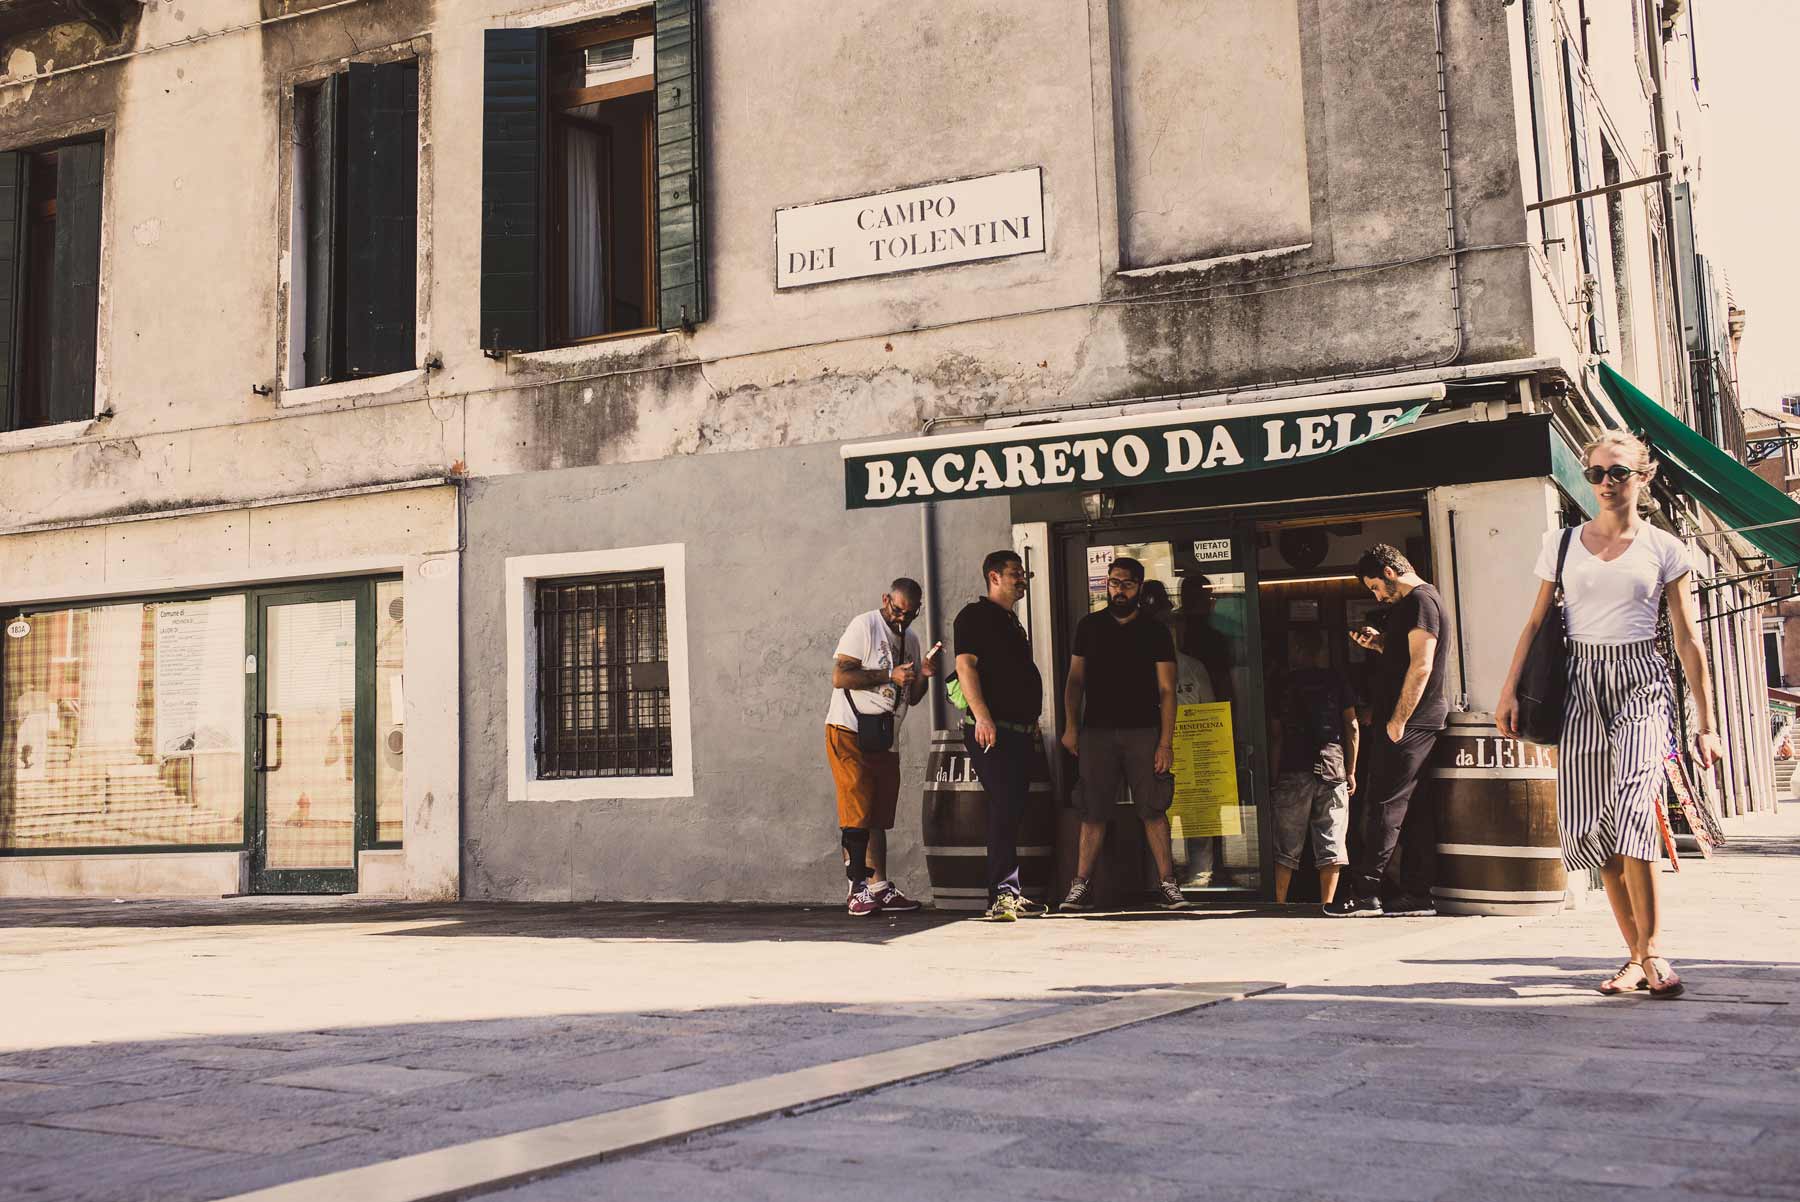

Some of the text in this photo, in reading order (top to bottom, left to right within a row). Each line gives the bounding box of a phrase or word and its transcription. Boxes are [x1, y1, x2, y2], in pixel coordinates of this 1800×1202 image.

[856, 196, 956, 231] CAMPO
[788, 215, 1031, 274] DEI TOLENTINI
[864, 436, 1151, 501] BACARETO
[1162, 425, 1244, 473] DA
[1194, 541, 1229, 550] VIETATO
[1455, 748, 1474, 767] da
[936, 766, 948, 782] da
